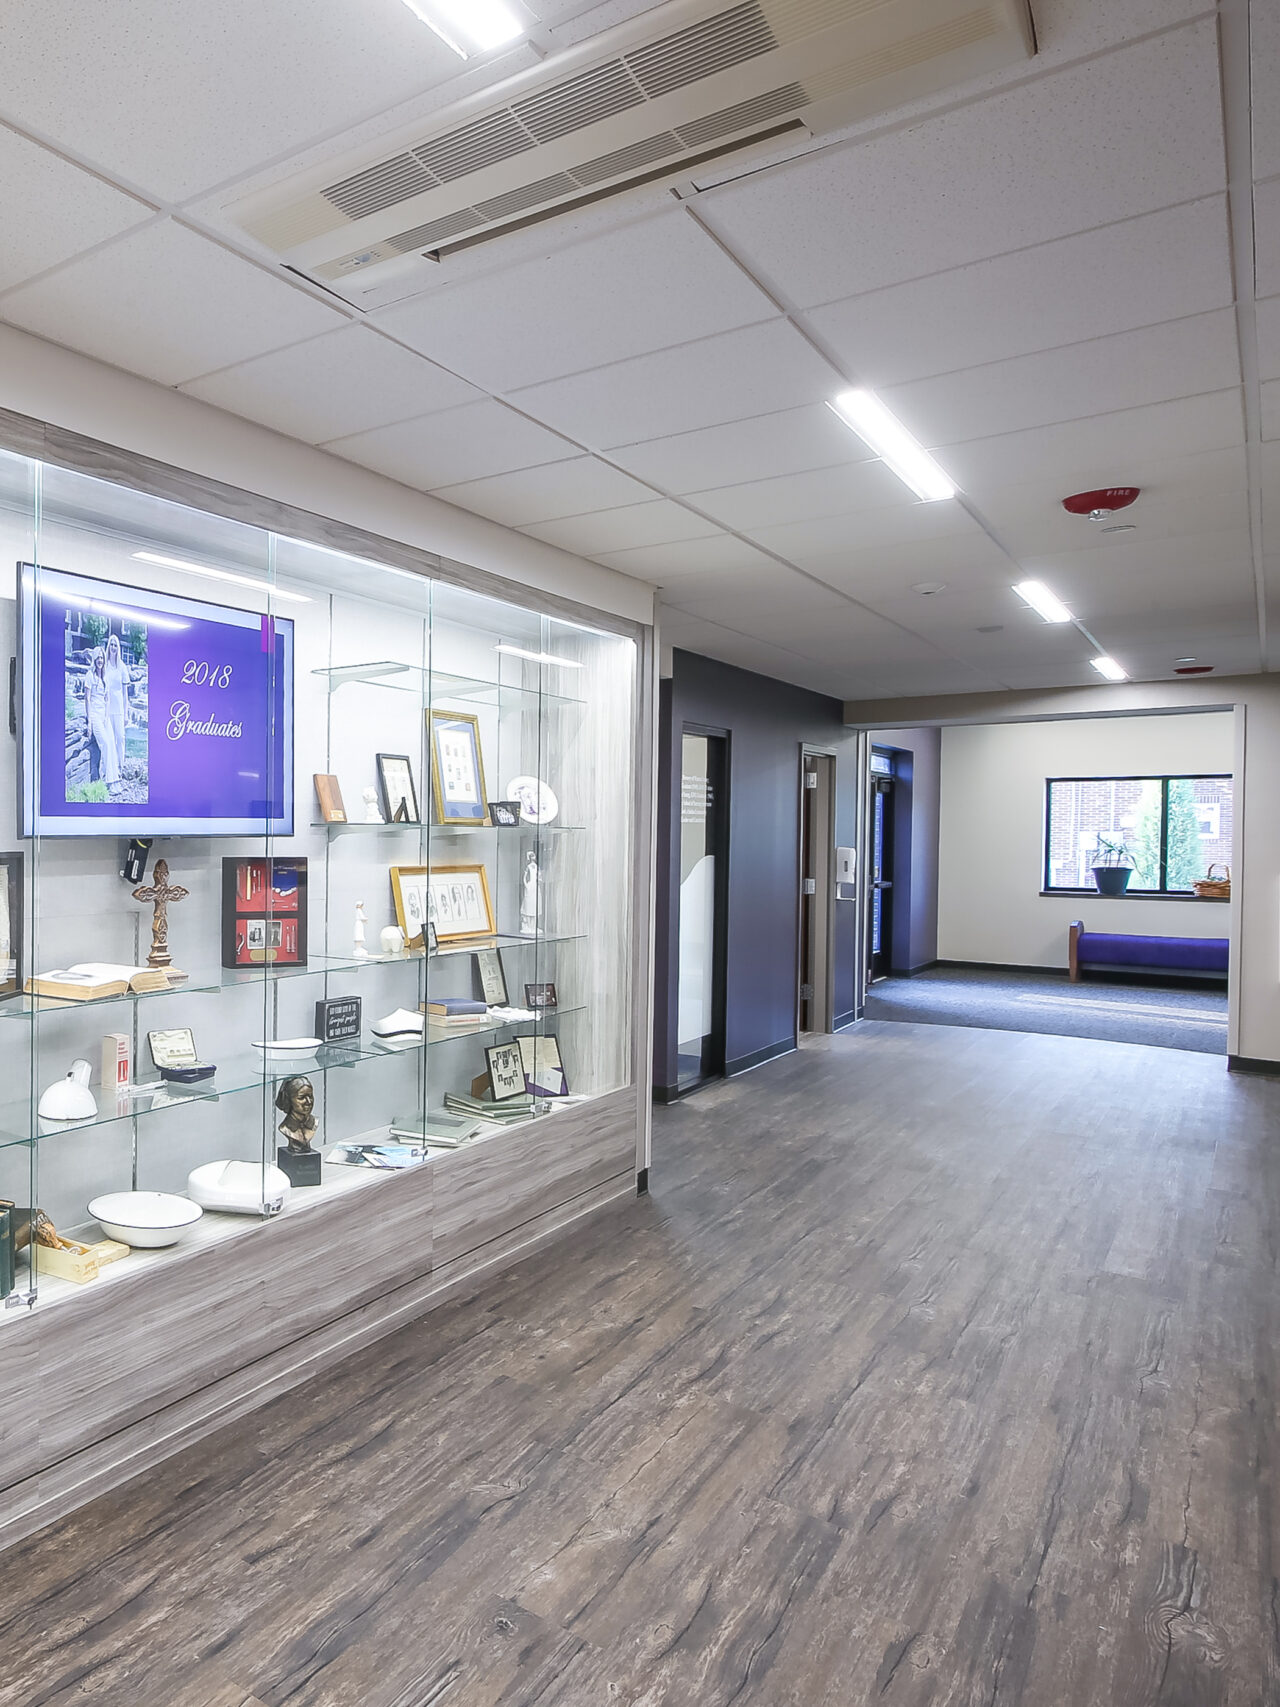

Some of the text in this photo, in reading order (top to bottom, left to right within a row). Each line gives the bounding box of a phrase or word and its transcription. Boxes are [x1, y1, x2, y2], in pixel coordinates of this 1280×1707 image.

[1106, 489, 1131, 497] FIRE
[180, 659, 233, 689] 2018
[166, 700, 244, 741] Graduates
